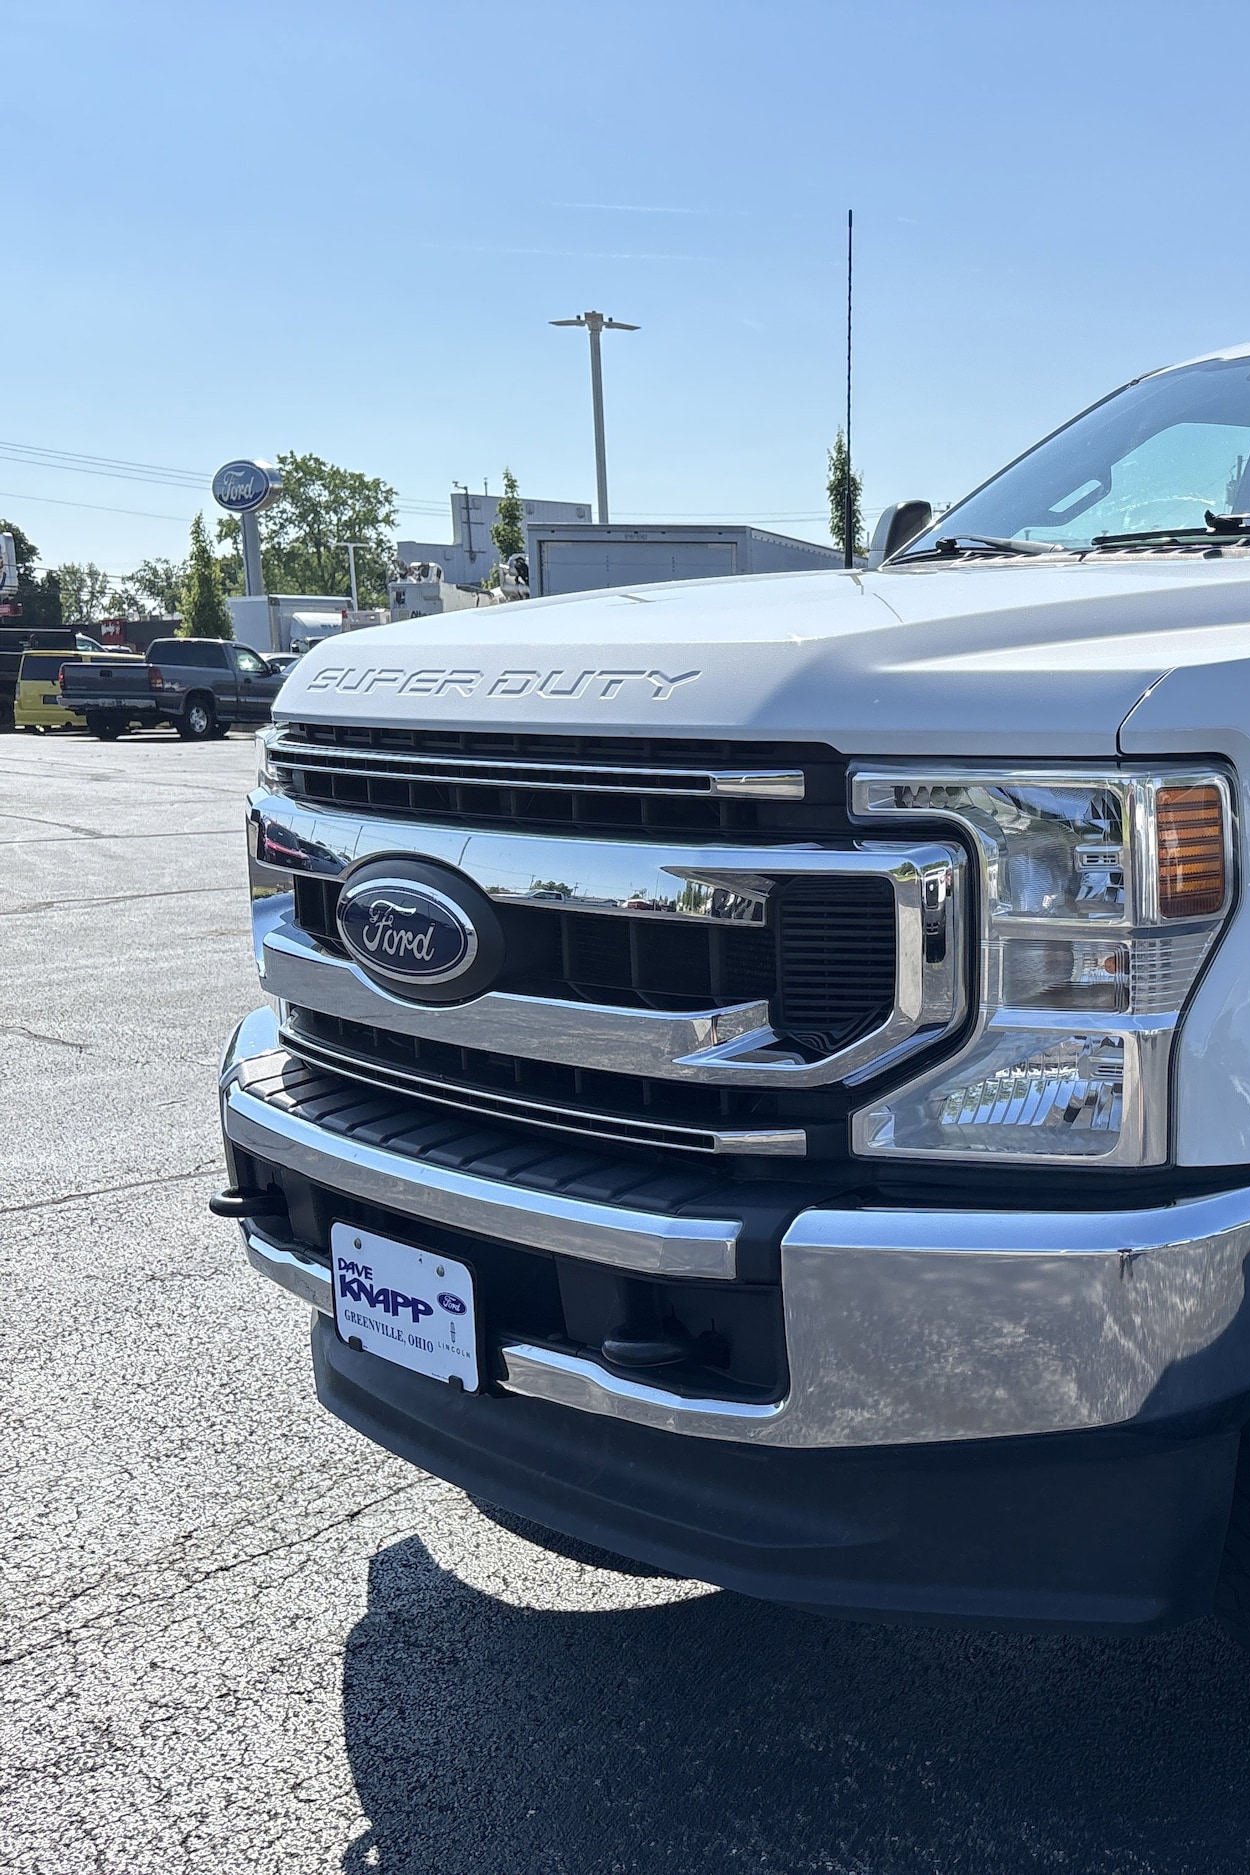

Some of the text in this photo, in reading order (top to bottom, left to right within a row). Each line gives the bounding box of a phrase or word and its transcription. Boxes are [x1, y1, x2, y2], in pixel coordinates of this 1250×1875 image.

[221, 470, 255, 502] Ford
[306, 667, 702, 701] SUPER DUTY
[362, 899, 436, 962] Ford
[337, 1256, 373, 1280] DAVE
[339, 1274, 434, 1324] KNAPP
[442, 1295, 461, 1312] Ford
[344, 1308, 434, 1354] GREENVILLE, OHIO
[437, 1341, 471, 1359] LINCOLN
